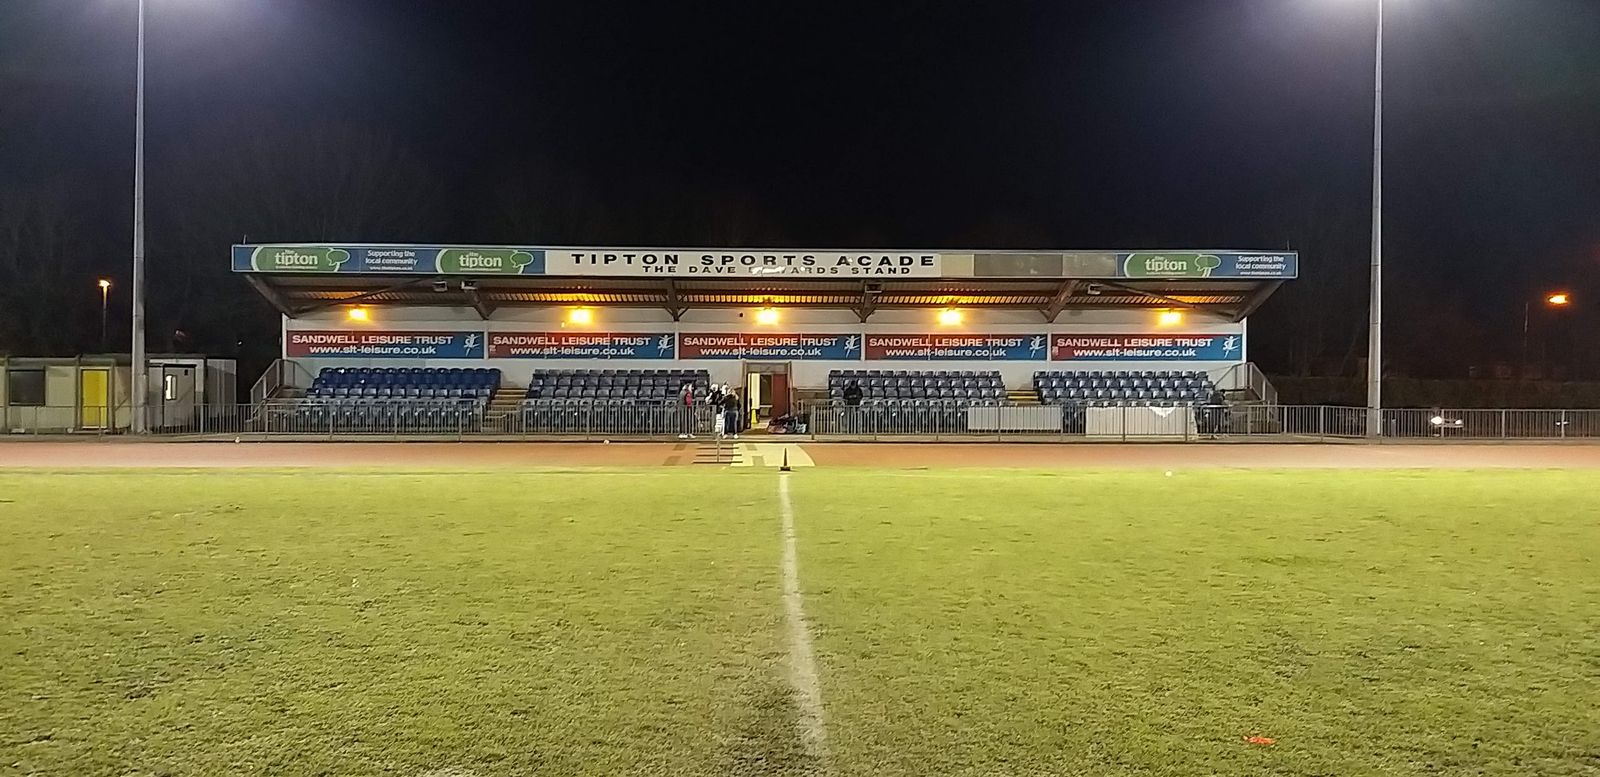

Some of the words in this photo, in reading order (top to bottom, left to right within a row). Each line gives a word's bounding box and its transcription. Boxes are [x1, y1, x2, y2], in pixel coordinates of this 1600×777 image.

[275, 252, 318, 265] tipton
[368, 250, 403, 258] Supporting
[459, 254, 502, 267] tipton
[571, 254, 678, 265] TIPTON
[701, 255, 816, 266] SPORTS
[836, 256, 934, 266] ACADE
[1145, 259, 1187, 272] tipton
[292, 335, 358, 344] SANDWELL
[362, 335, 412, 344] LEISURE
[414, 335, 453, 344] TRUST
[493, 336, 559, 345] SANDWELL
[562, 336, 610, 345] LEISURE
[613, 336, 651, 345] TRUST
[684, 337, 747, 346] SANDWELL
[750, 337, 798, 346] LEISURE
[801, 337, 838, 346] TRUST
[869, 338, 932, 347] SANDWELL
[935, 338, 983, 347] LEISURE
[986, 338, 1023, 347] TRUST
[1057, 338, 1121, 347] SANDWELL
[1124, 338, 1172, 347] LEISURE
[1174, 338, 1213, 347] TRUST
[309, 345, 436, 354] www.slt-leisure.co.uk
[510, 347, 635, 356] www.slt-leisure.co.uk
[700, 347, 821, 356] www.slt-leisure.co.uk
[886, 348, 1006, 356] www.slt-leisure.co.uk
[1073, 348, 1196, 356] www.slt-leisure.co.uk
